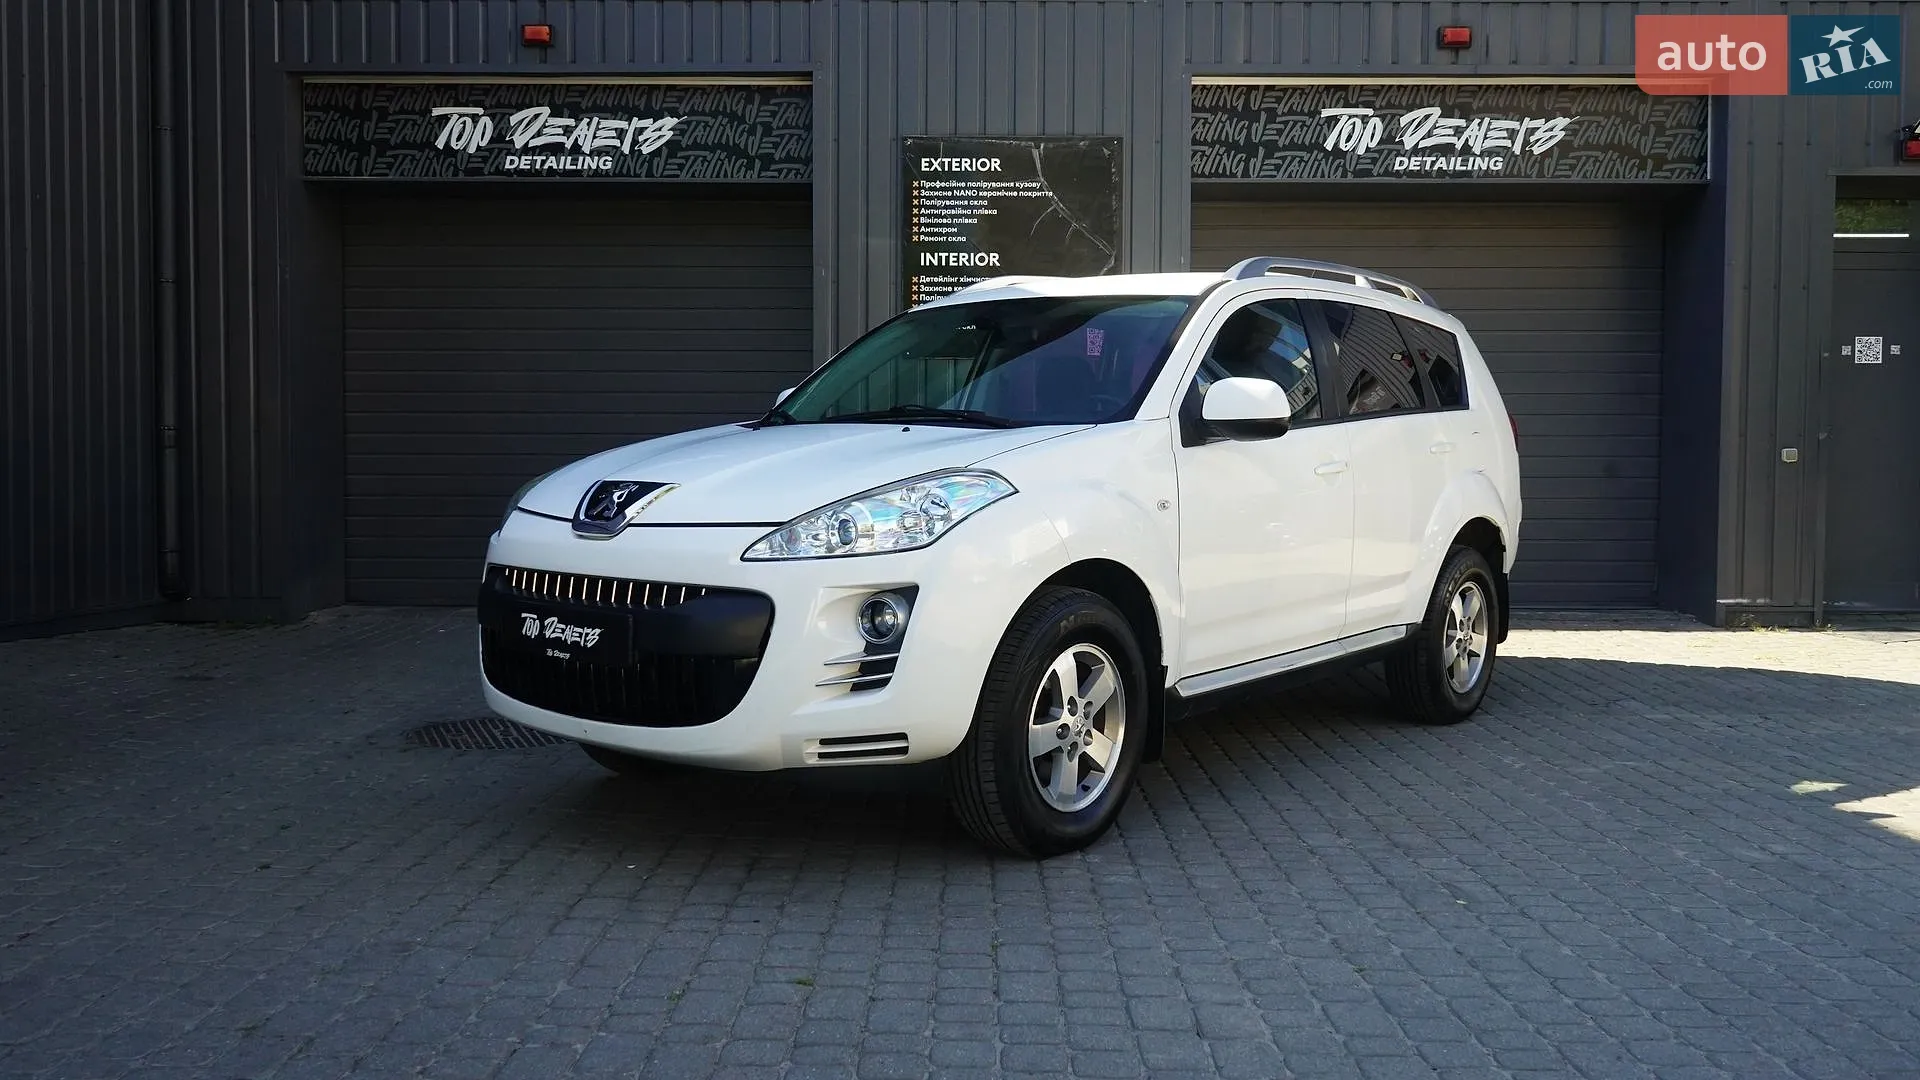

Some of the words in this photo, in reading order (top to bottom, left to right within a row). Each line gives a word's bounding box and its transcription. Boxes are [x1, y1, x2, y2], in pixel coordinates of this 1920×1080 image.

[505, 155, 613, 171] DETAILING
[921, 158, 1001, 171] EXTERIOR
[1394, 156, 1504, 171] DETAILING
[920, 180, 966, 190] Професійне
[967, 180, 1014, 190] полірування
[1015, 182, 1041, 190] кузову
[979, 190, 1018, 199] керамічне
[1019, 191, 1053, 199] покриття
[920, 199, 968, 208] Полірування
[920, 208, 971, 217] Антигравійна
[920, 226, 957, 235] Антихром
[920, 252, 1001, 267] INTERIOR
[920, 276, 958, 286] Детейлінг
